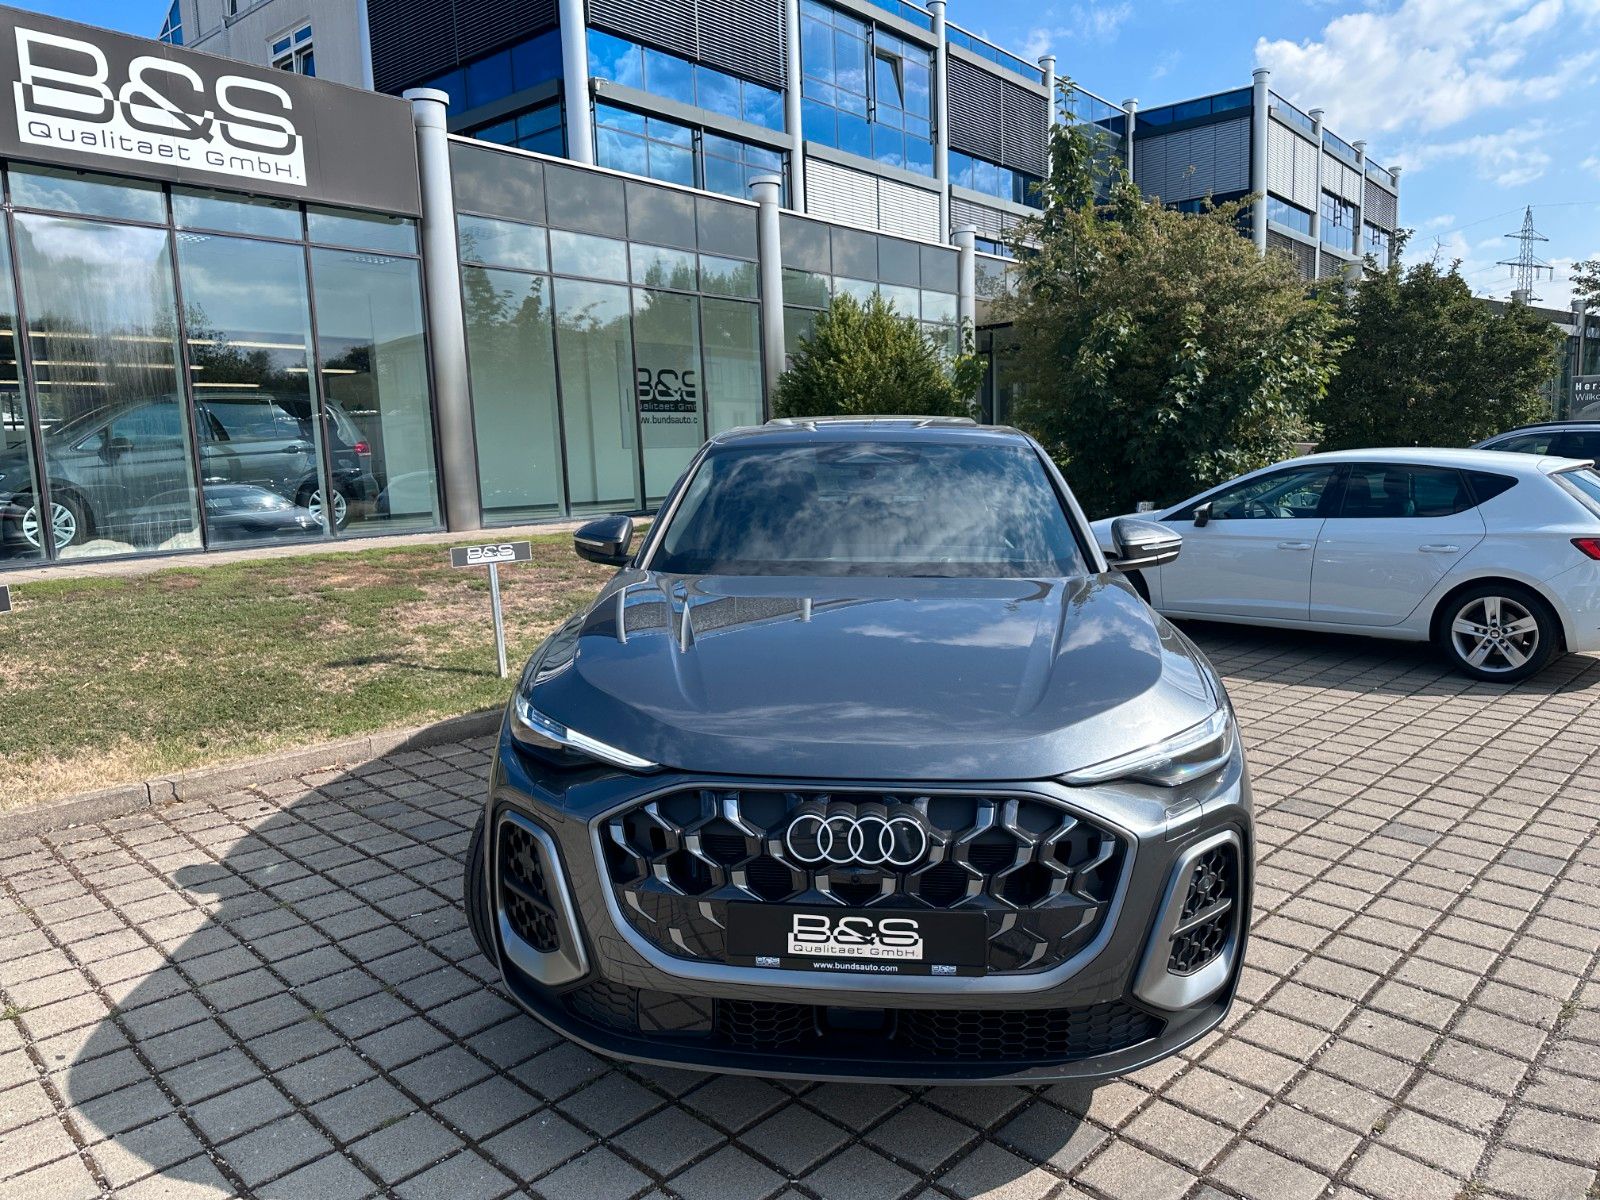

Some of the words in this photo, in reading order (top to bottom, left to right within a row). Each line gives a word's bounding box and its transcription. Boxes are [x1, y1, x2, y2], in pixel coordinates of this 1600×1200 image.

[14, 26, 298, 156] B&S
[28, 120, 191, 161] Qualitaet
[205, 150, 300, 179] GmbH.
[1575, 382, 1600, 391] Her
[467, 544, 515, 560] B&S
[793, 914, 920, 947] B&S
[793, 944, 864, 955] Qualitaet
[813, 961, 898, 972] www.bundsauto.com
